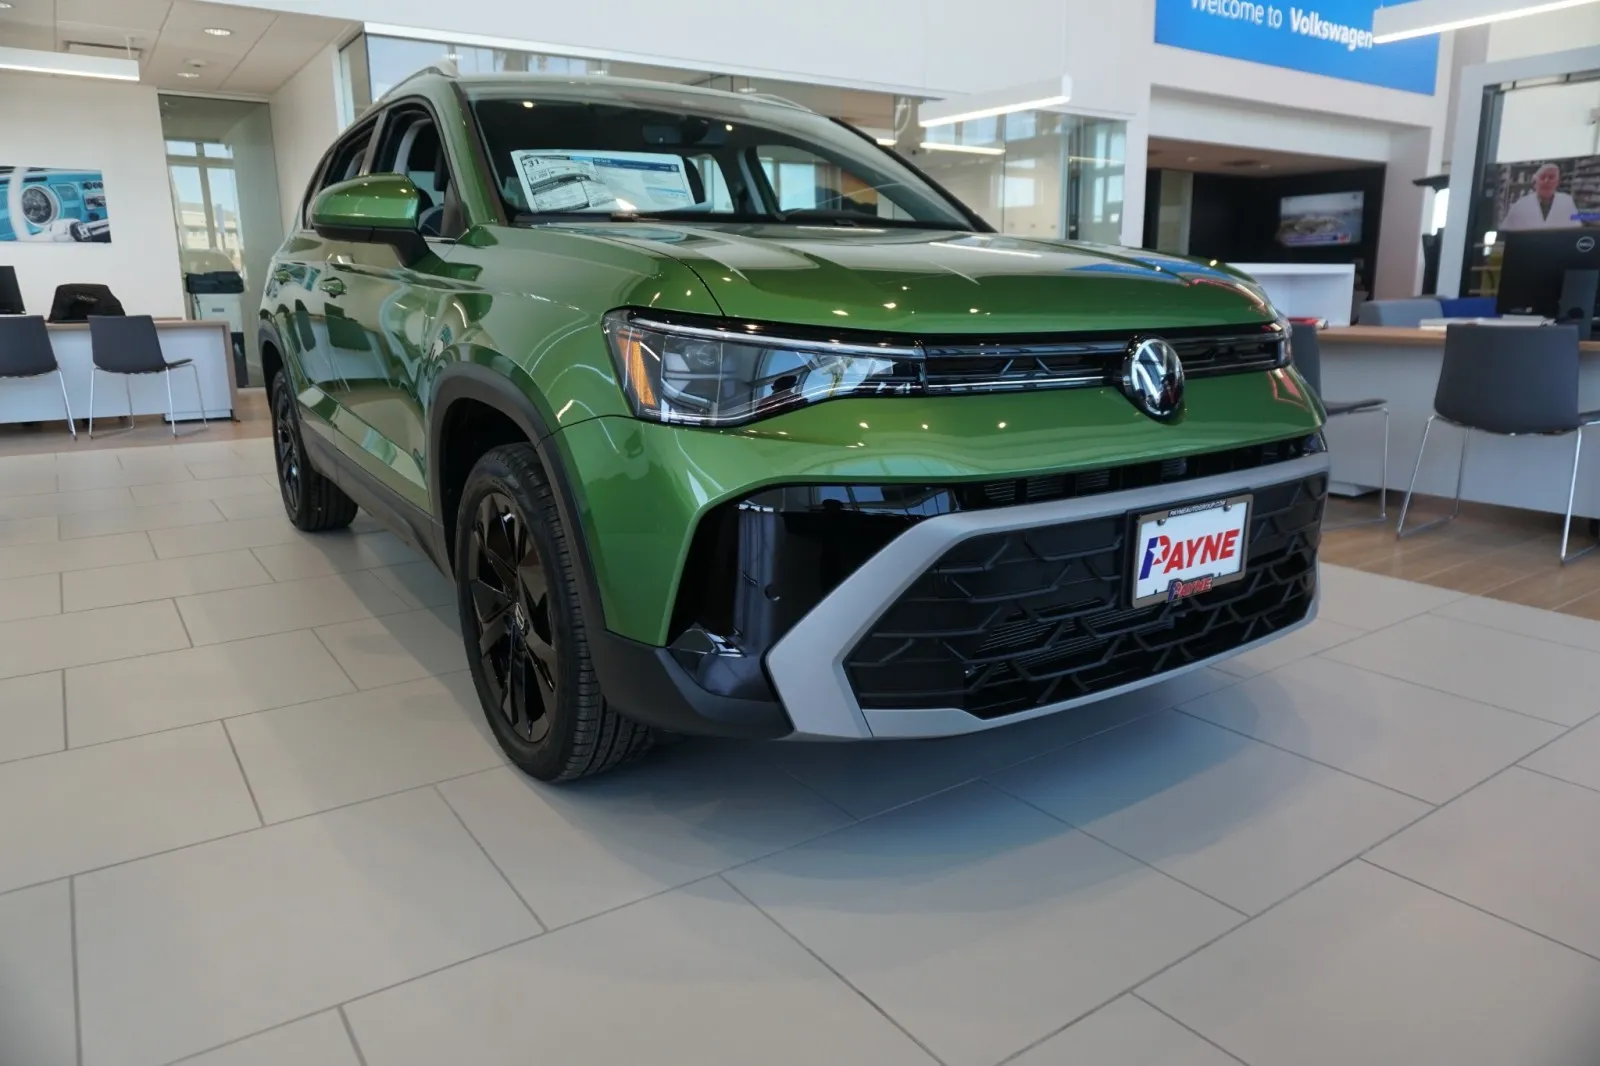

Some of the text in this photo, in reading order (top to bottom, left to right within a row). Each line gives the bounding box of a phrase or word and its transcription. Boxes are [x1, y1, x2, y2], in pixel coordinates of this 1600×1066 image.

[1267, 5, 1283, 29] to
[1290, 7, 1373, 51] Volkswagen
[1169, 500, 1227, 517] PAYNEAUTOGROUP.COM
[1139, 528, 1240, 580] PAYNE
[1167, 577, 1212, 601] PAYNE
